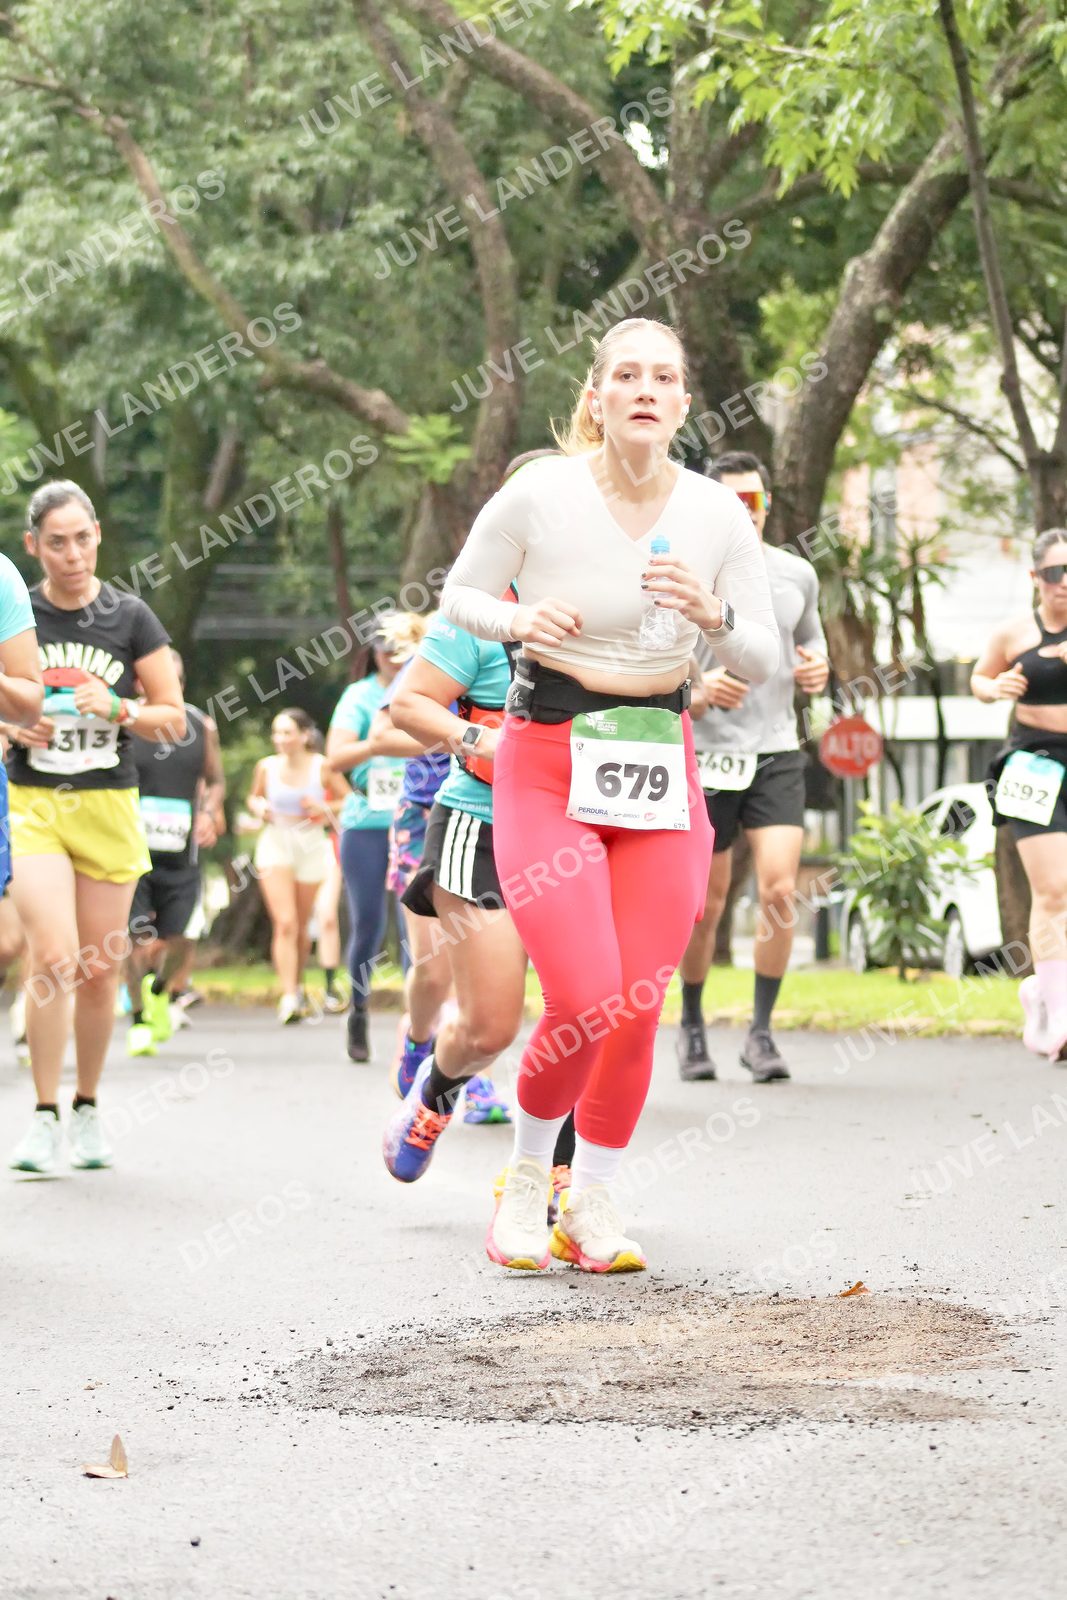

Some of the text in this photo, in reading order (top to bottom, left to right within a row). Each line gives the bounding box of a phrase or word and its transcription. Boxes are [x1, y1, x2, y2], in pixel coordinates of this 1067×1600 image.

[828, 734, 880, 758] ALTO
[595, 762, 669, 801] 679
[578, 806, 609, 816] PERDURA
